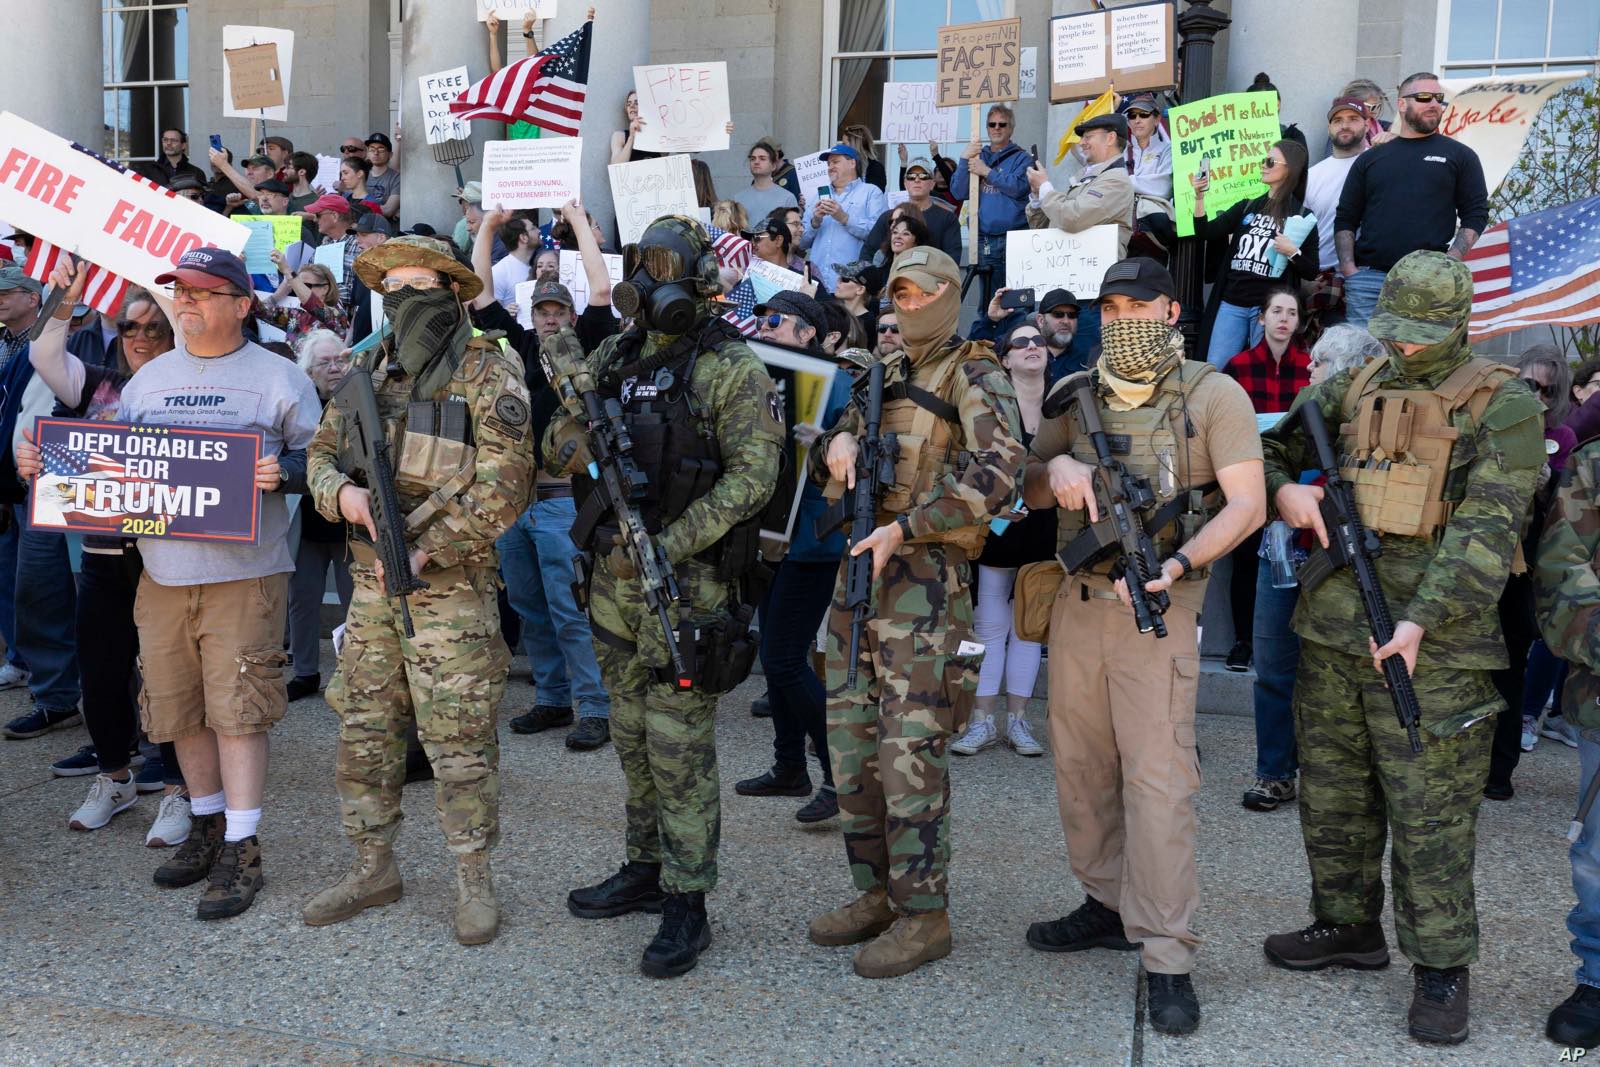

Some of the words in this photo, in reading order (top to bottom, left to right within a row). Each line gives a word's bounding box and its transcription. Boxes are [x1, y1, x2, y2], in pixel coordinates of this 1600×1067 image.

[1116, 20, 1159, 31] government
[1117, 14, 1136, 22] when
[944, 25, 1018, 45] #ReopenNH
[1058, 32, 1081, 41] people
[1117, 33, 1134, 41] fears
[1058, 44, 1098, 55] government
[1117, 41, 1142, 50] people
[941, 41, 1016, 73] FACTS
[1058, 62, 1087, 70] tyranny.
[962, 67, 994, 78] NOT
[427, 75, 462, 89] FREE
[644, 66, 713, 105] FREE
[941, 73, 1012, 103] FEAR
[896, 83, 936, 101] STO
[1176, 104, 1236, 138] Covid-19
[1437, 95, 1528, 136] take.
[886, 122, 948, 141] CHURCH
[1180, 137, 1205, 156] BUT
[1211, 129, 1235, 145] THE
[803, 156, 825, 168] WEE
[1202, 147, 1222, 160] ARE
[0, 147, 87, 214] FIRE
[498, 180, 532, 188] GOVERNOR
[534, 179, 564, 187] SUNUNU,
[1188, 165, 1233, 186] AKE
[517, 189, 552, 198] REMEMBER
[103, 199, 218, 266] FAUC
[1249, 227, 1272, 237] are
[1032, 234, 1081, 253] COVID
[1021, 259, 1033, 271] IS
[1047, 255, 1071, 268] NOT
[1080, 257, 1098, 267] THE
[1252, 262, 1268, 276] HELL
[1008, 274, 1047, 292] WST
[163, 395, 226, 407] TRUMP
[68, 431, 228, 462] DEPLORABLES
[124, 458, 169, 480] FOR
[68, 477, 221, 517] TRUMP
[122, 518, 166, 536] 2020
